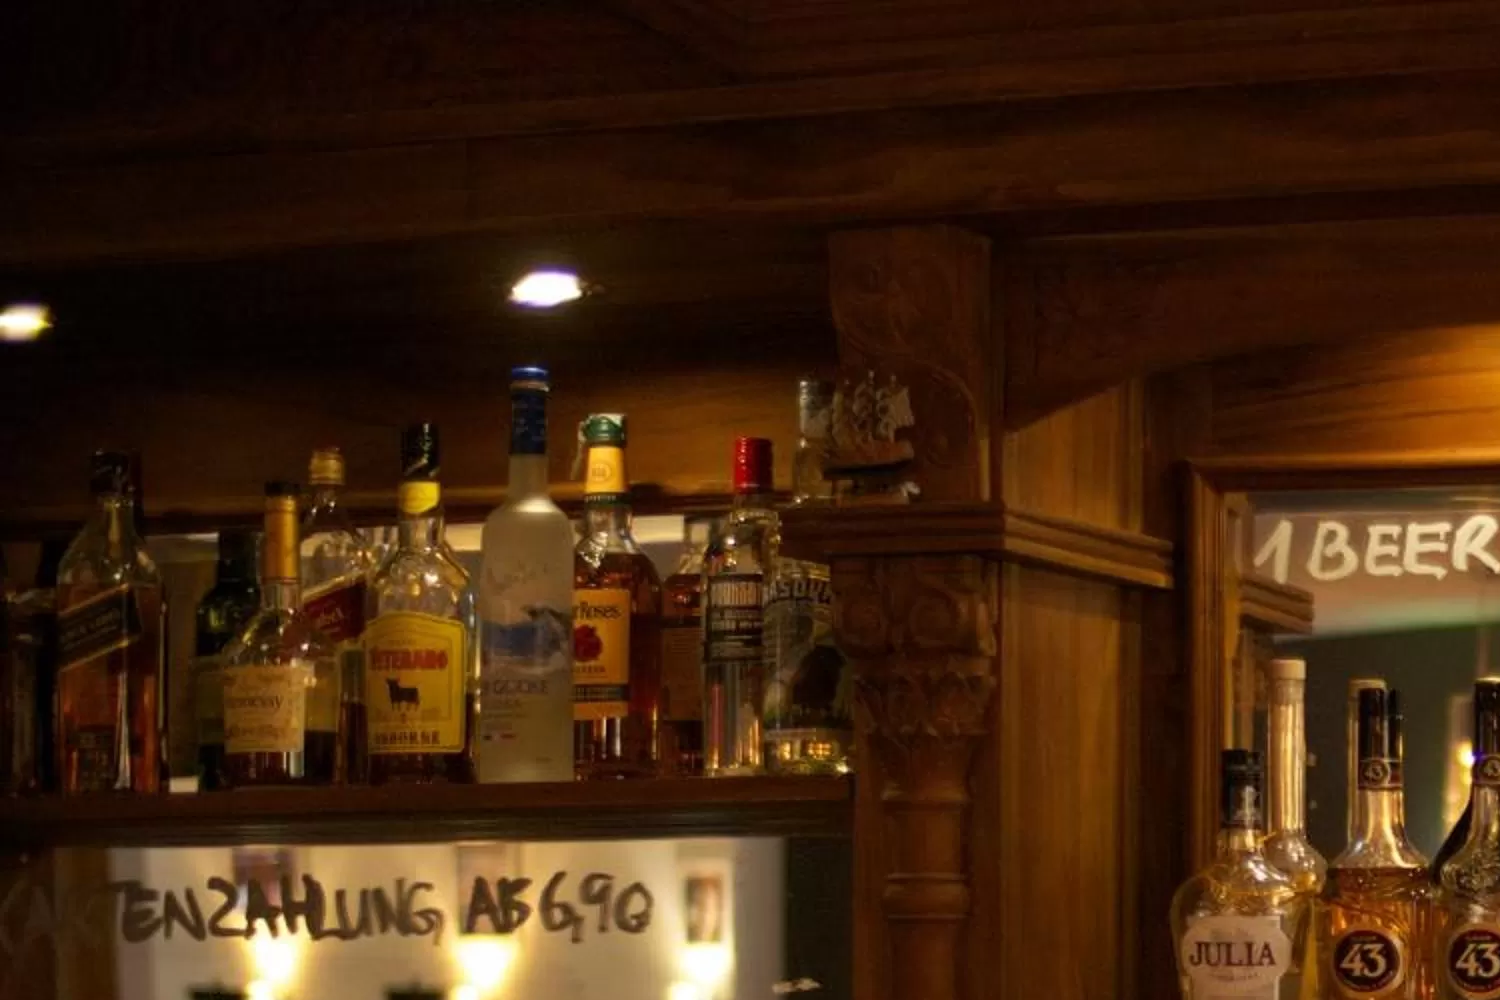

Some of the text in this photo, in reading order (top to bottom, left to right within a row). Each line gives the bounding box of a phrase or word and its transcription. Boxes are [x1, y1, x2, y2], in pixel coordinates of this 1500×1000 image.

[1254, 519, 1293, 584] 1
[1189, 941, 1277, 968] JULIA
[1339, 943, 1389, 978] 43
